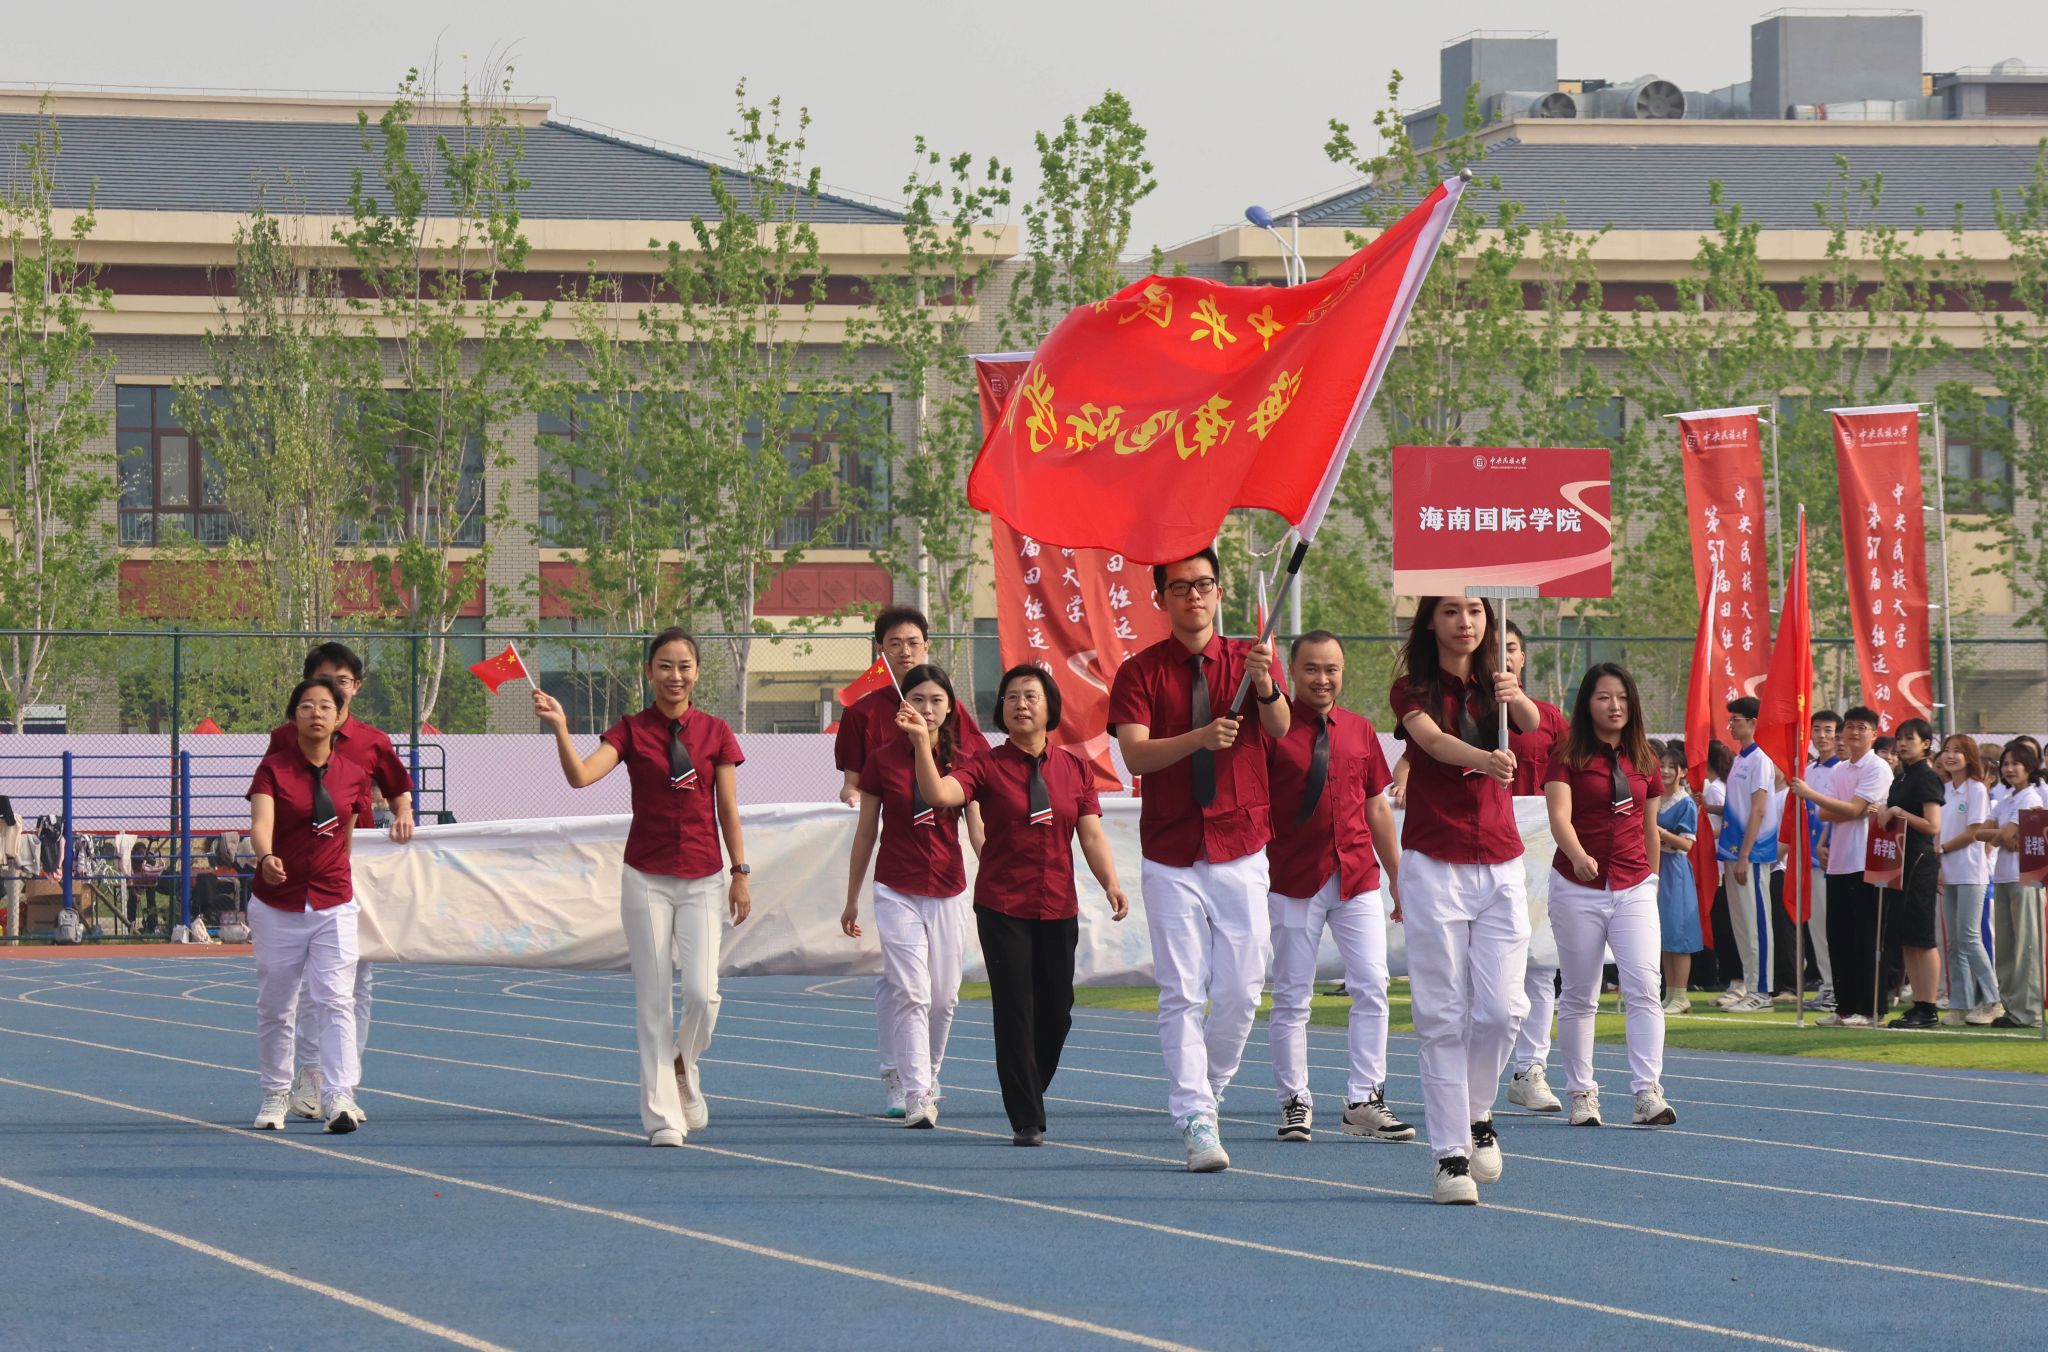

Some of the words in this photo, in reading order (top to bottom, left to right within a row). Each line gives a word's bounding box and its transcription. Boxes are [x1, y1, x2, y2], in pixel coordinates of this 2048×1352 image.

[1490, 456, 1527, 465] 中央民族大学
[1418, 506, 1582, 533] 海南国际学院
[1061, 548, 1085, 623] 大学
[1733, 486, 1754, 651] 中央民族大学
[1890, 483, 1908, 649] 中央民族大学
